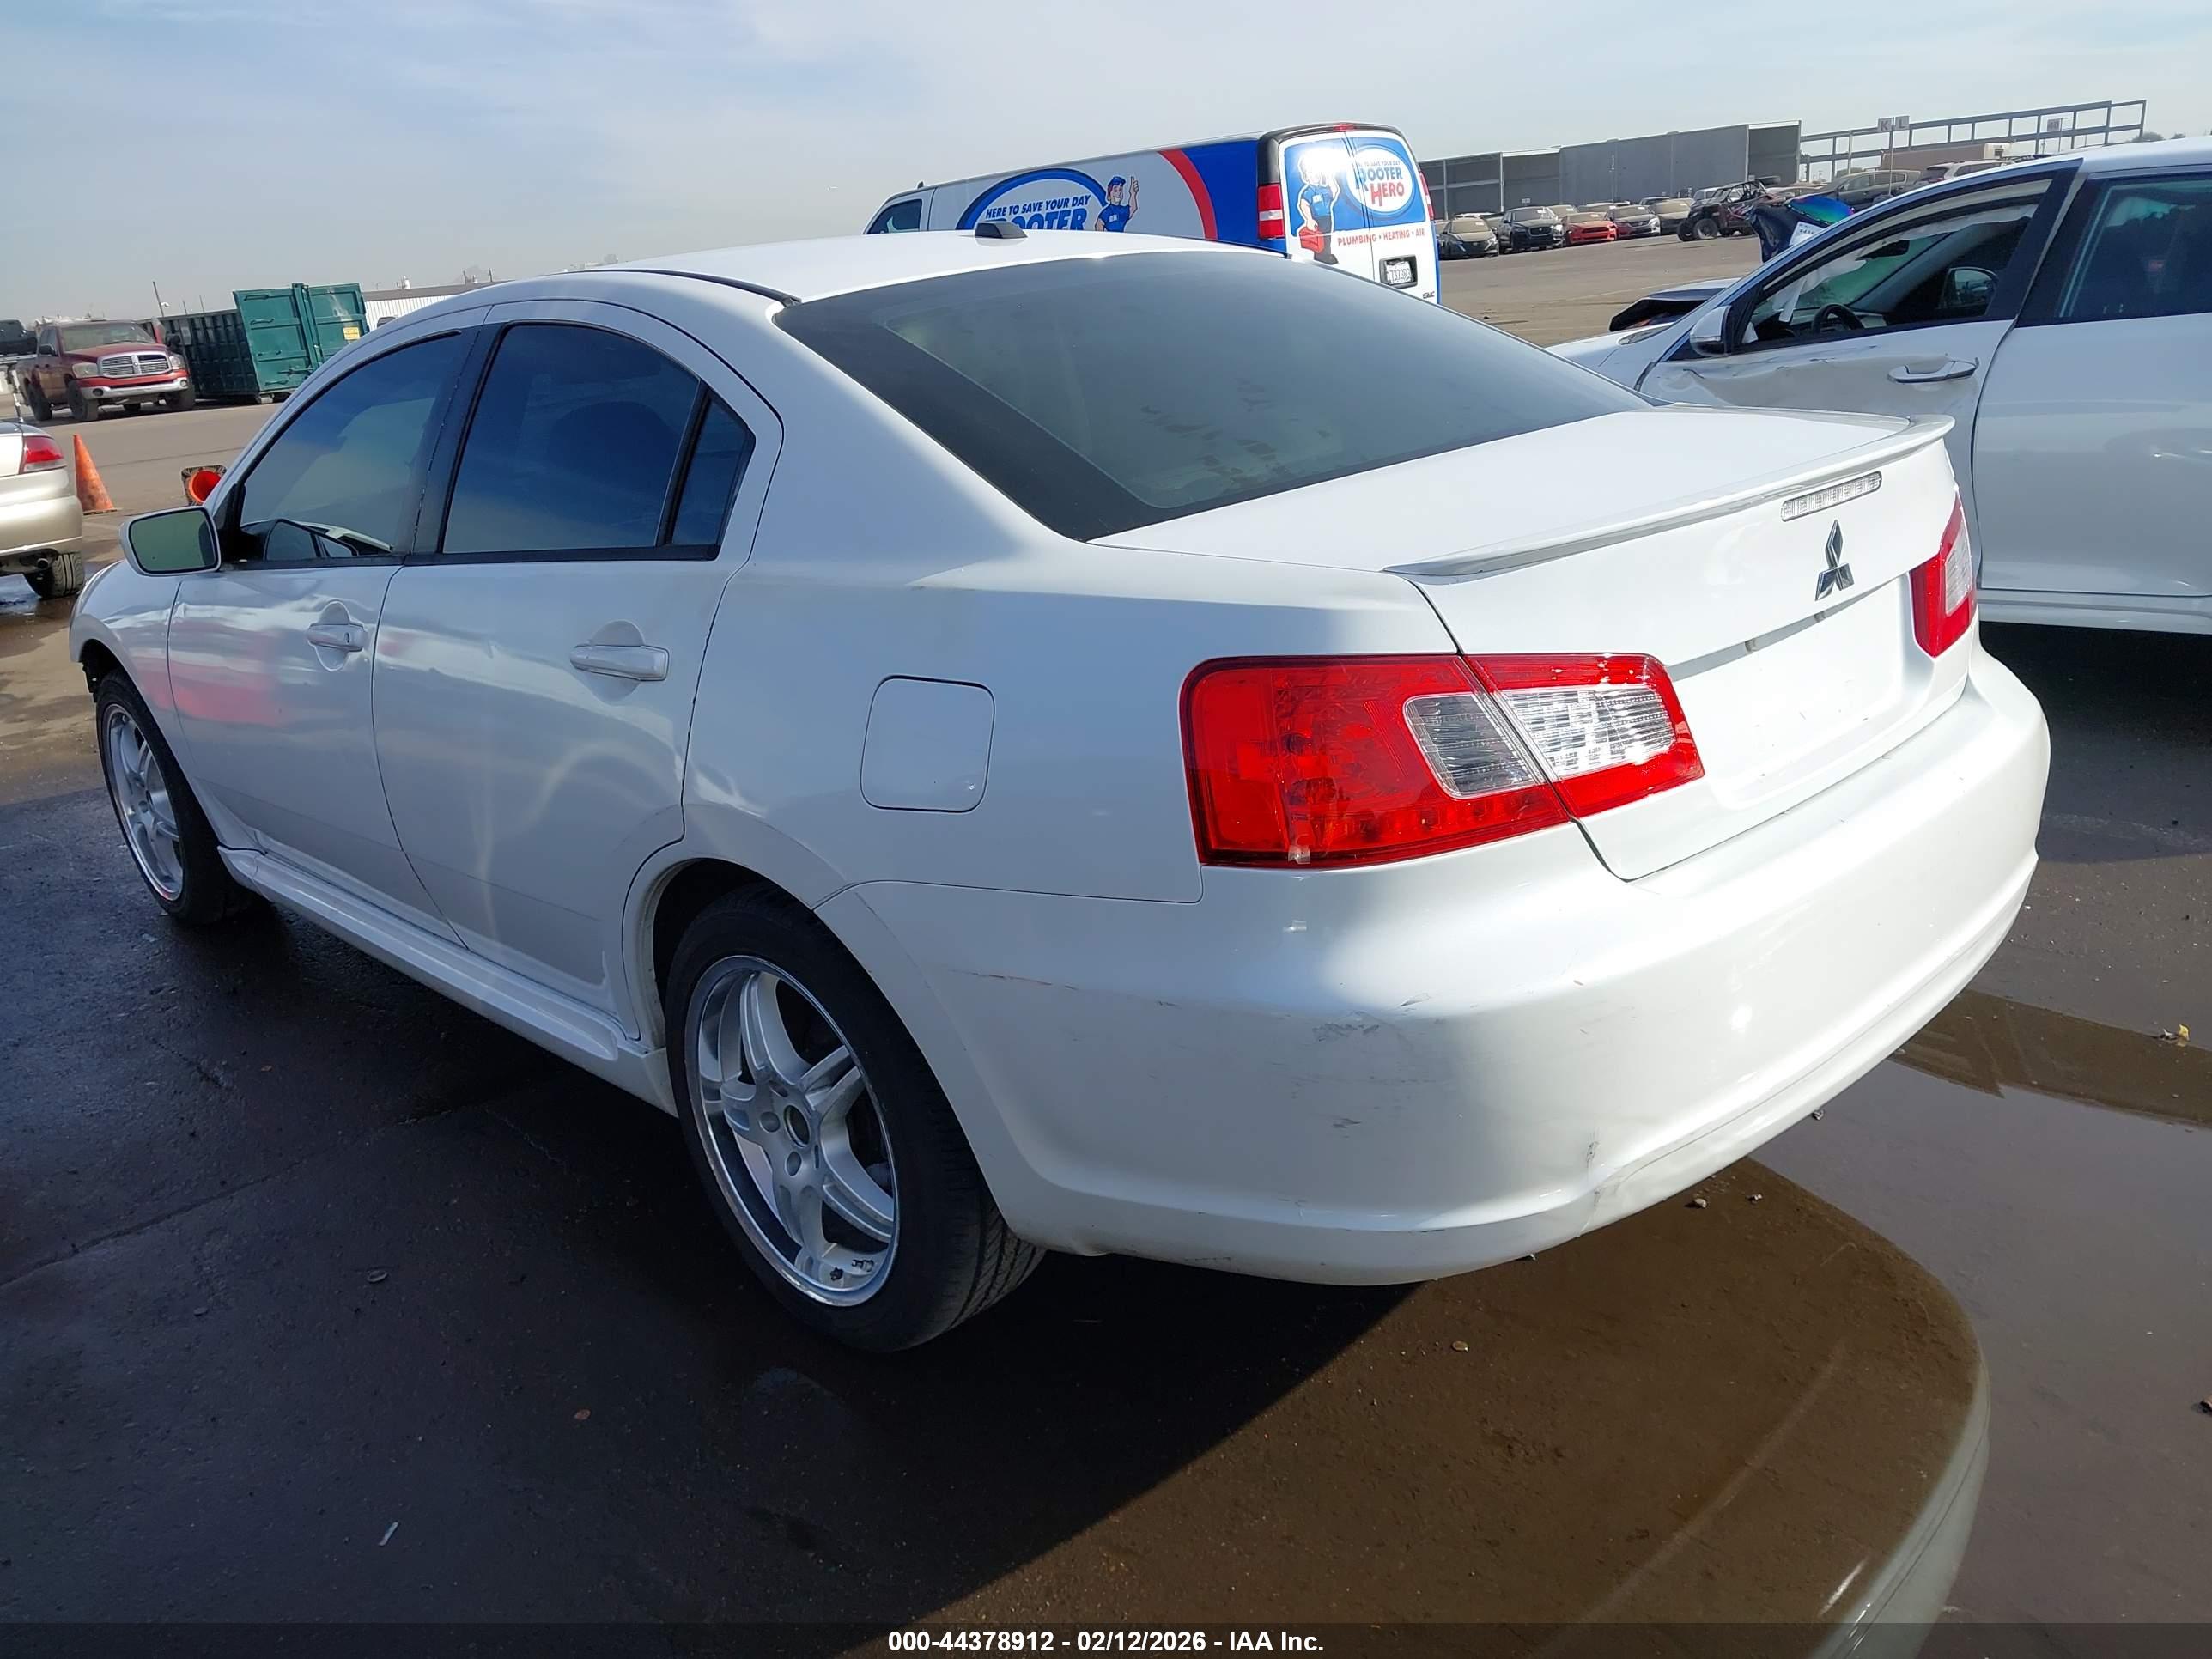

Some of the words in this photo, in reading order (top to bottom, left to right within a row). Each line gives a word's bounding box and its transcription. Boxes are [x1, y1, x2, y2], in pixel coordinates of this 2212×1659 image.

[1881, 120, 1888, 131] K
[1352, 166, 1403, 191] ROOTER
[1370, 181, 1405, 206] HERO
[986, 207, 1007, 219] HERE
[1008, 204, 1020, 216] TO
[1021, 201, 1044, 214] SAVE
[1046, 198, 1070, 210] YOUR
[1073, 194, 1091, 206] DAY
[1338, 234, 1377, 246] PLUMBING
[1383, 230, 1410, 240] HEATING
[1415, 228, 1425, 236] AIR
